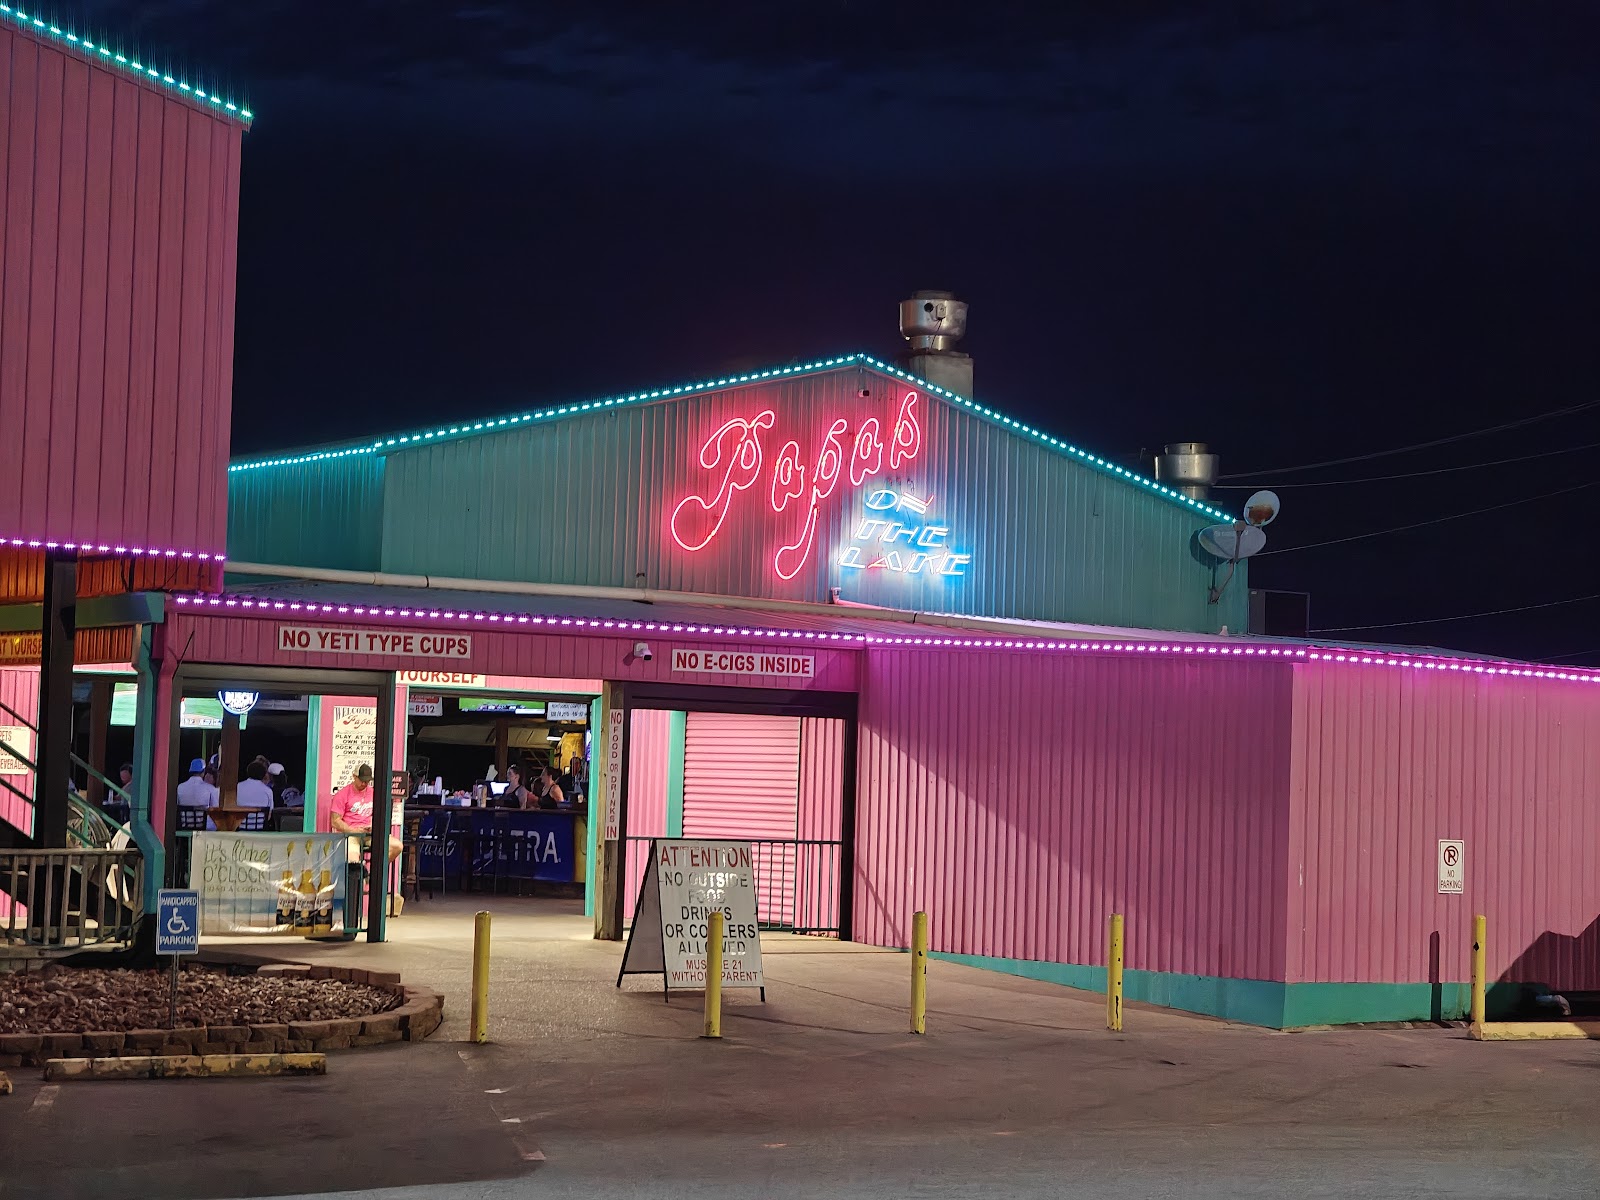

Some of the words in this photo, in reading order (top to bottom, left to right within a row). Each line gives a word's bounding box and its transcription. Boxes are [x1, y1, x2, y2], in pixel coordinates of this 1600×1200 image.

[865, 490, 934, 514] ON
[854, 517, 949, 547] THE
[837, 546, 970, 575] LAKE
[283, 629, 311, 648] NO
[317, 631, 359, 651] YETI
[366, 634, 413, 653] TYPE
[419, 636, 468, 656] CUPS
[676, 652, 699, 669] NO
[704, 653, 755, 672] E-CIGS
[760, 656, 811, 674] INSIDE
[400, 671, 478, 684] YOURSELF
[335, 707, 373, 721] WELCOME
[610, 712, 622, 725] NO
[611, 727, 619, 759] FOOD
[610, 763, 619, 773] OR
[609, 776, 617, 823] DRINKS
[606, 826, 617, 839] IN
[660, 846, 750, 868] ATTENTION
[203, 865, 267, 884] O'CLOCK
[665, 871, 683, 886] NO
[689, 872, 748, 888] OUTSIDE
[1447, 870, 1455, 878] NO
[1440, 879, 1462, 889] PARKING
[689, 889, 726, 904] FOOD
[665, 924, 684, 938] OR
[689, 924, 756, 938] COERS
[160, 935, 196, 945] PARKING
[678, 941, 746, 956] ALLED
[686, 959, 707, 970] MUS
[732, 960, 742, 970] 21
[672, 971, 707, 981] WITHO
[720, 972, 758, 982] PARENT
